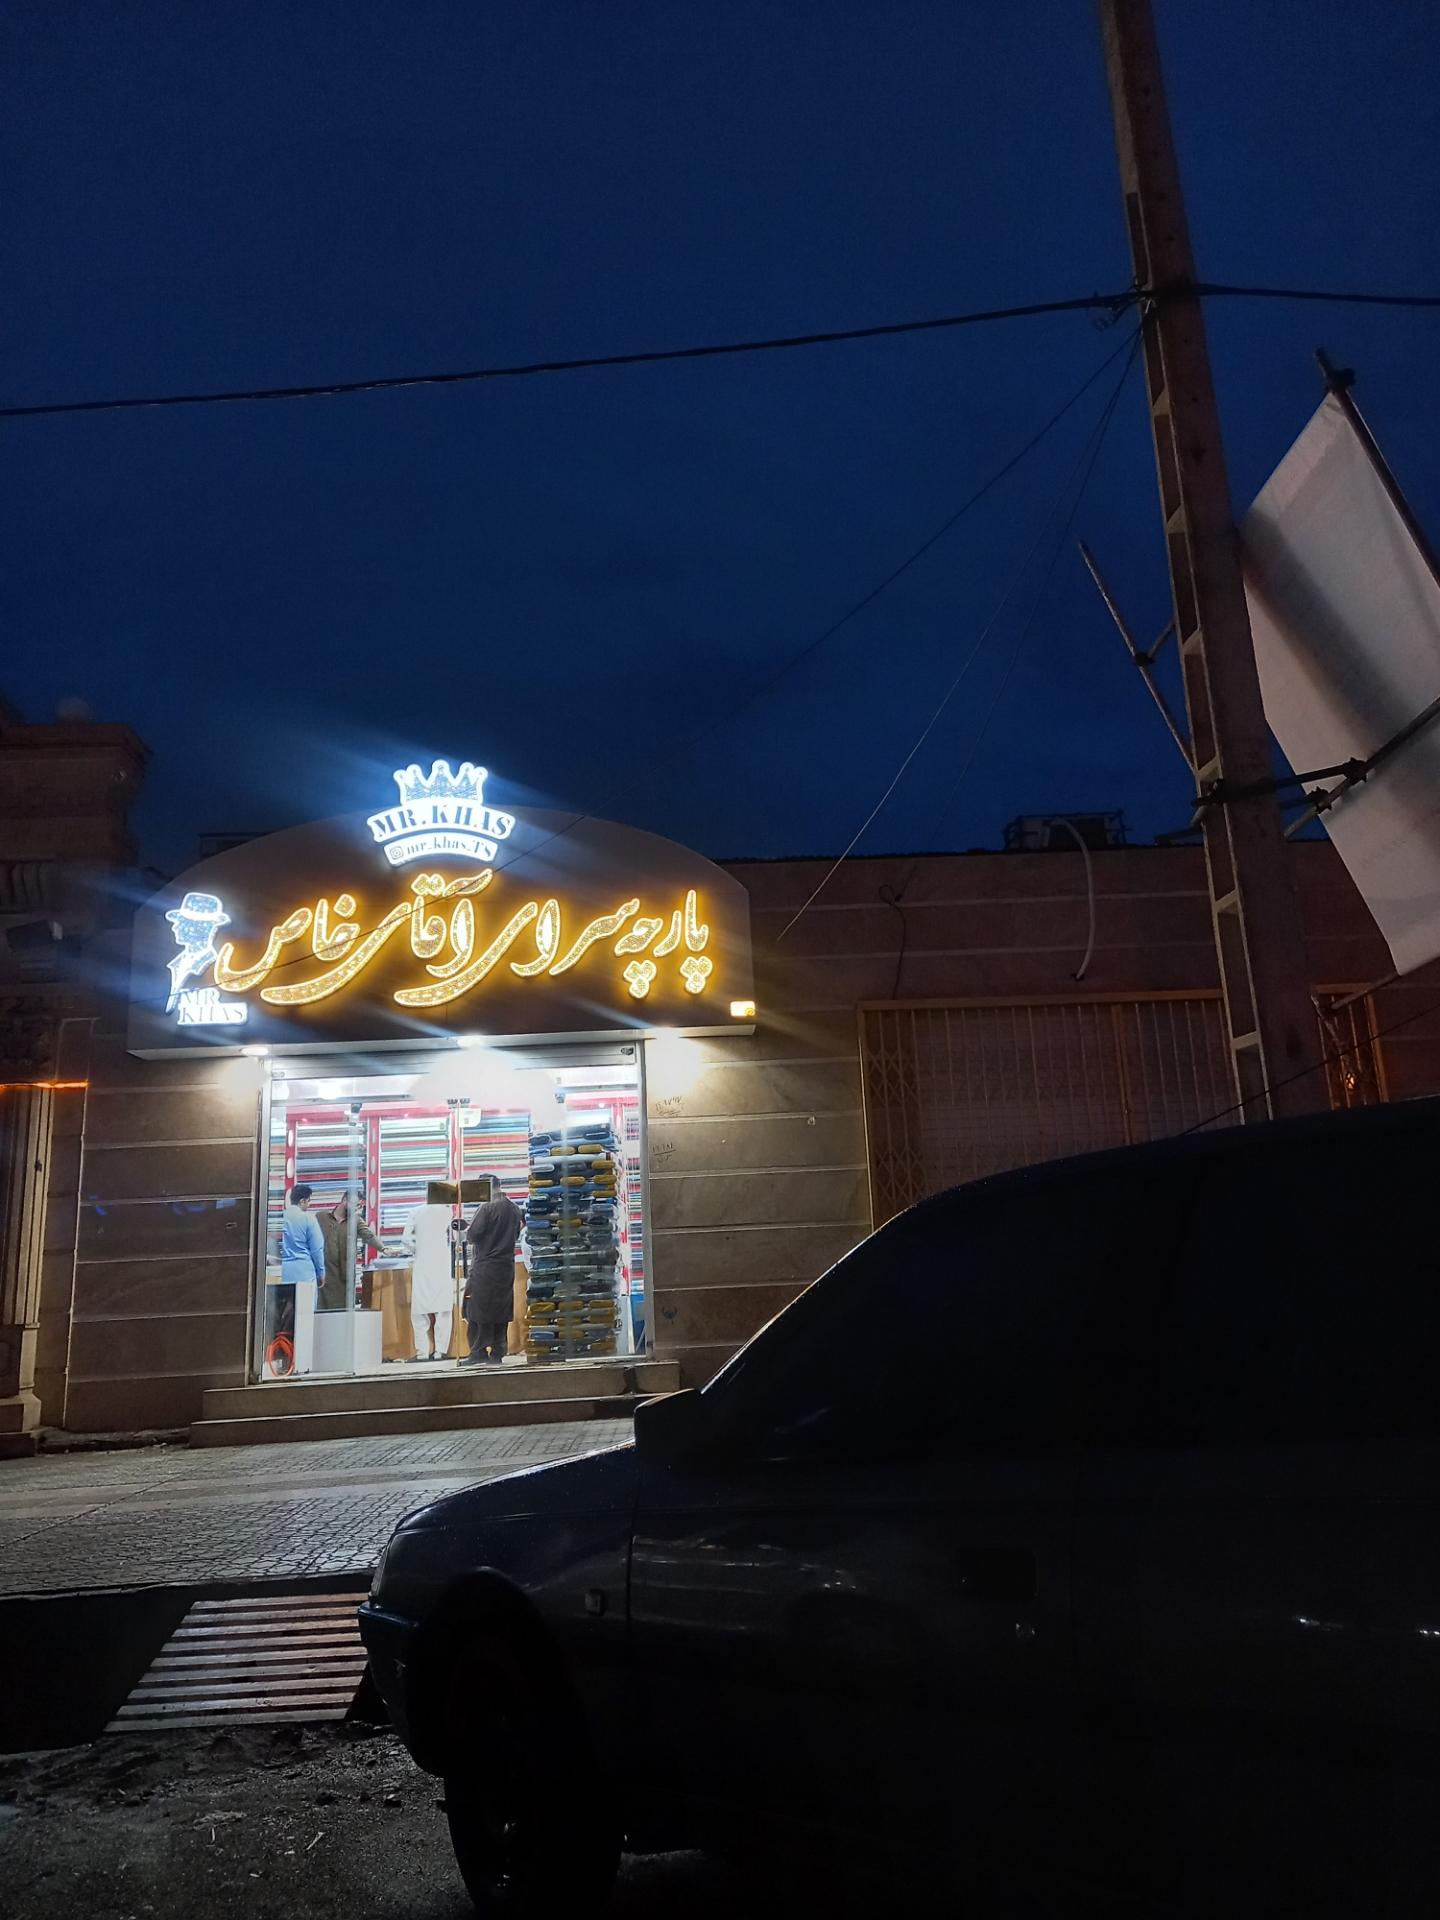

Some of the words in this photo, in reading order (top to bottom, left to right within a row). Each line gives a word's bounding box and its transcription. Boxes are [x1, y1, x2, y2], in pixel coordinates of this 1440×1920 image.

[213, 894, 360, 993] خاص
[260, 868, 493, 1006] آقای
[613, 888, 714, 999] پارچه
[179, 990, 215, 1006] MR
[180, 1005, 243, 1024] KHAS
